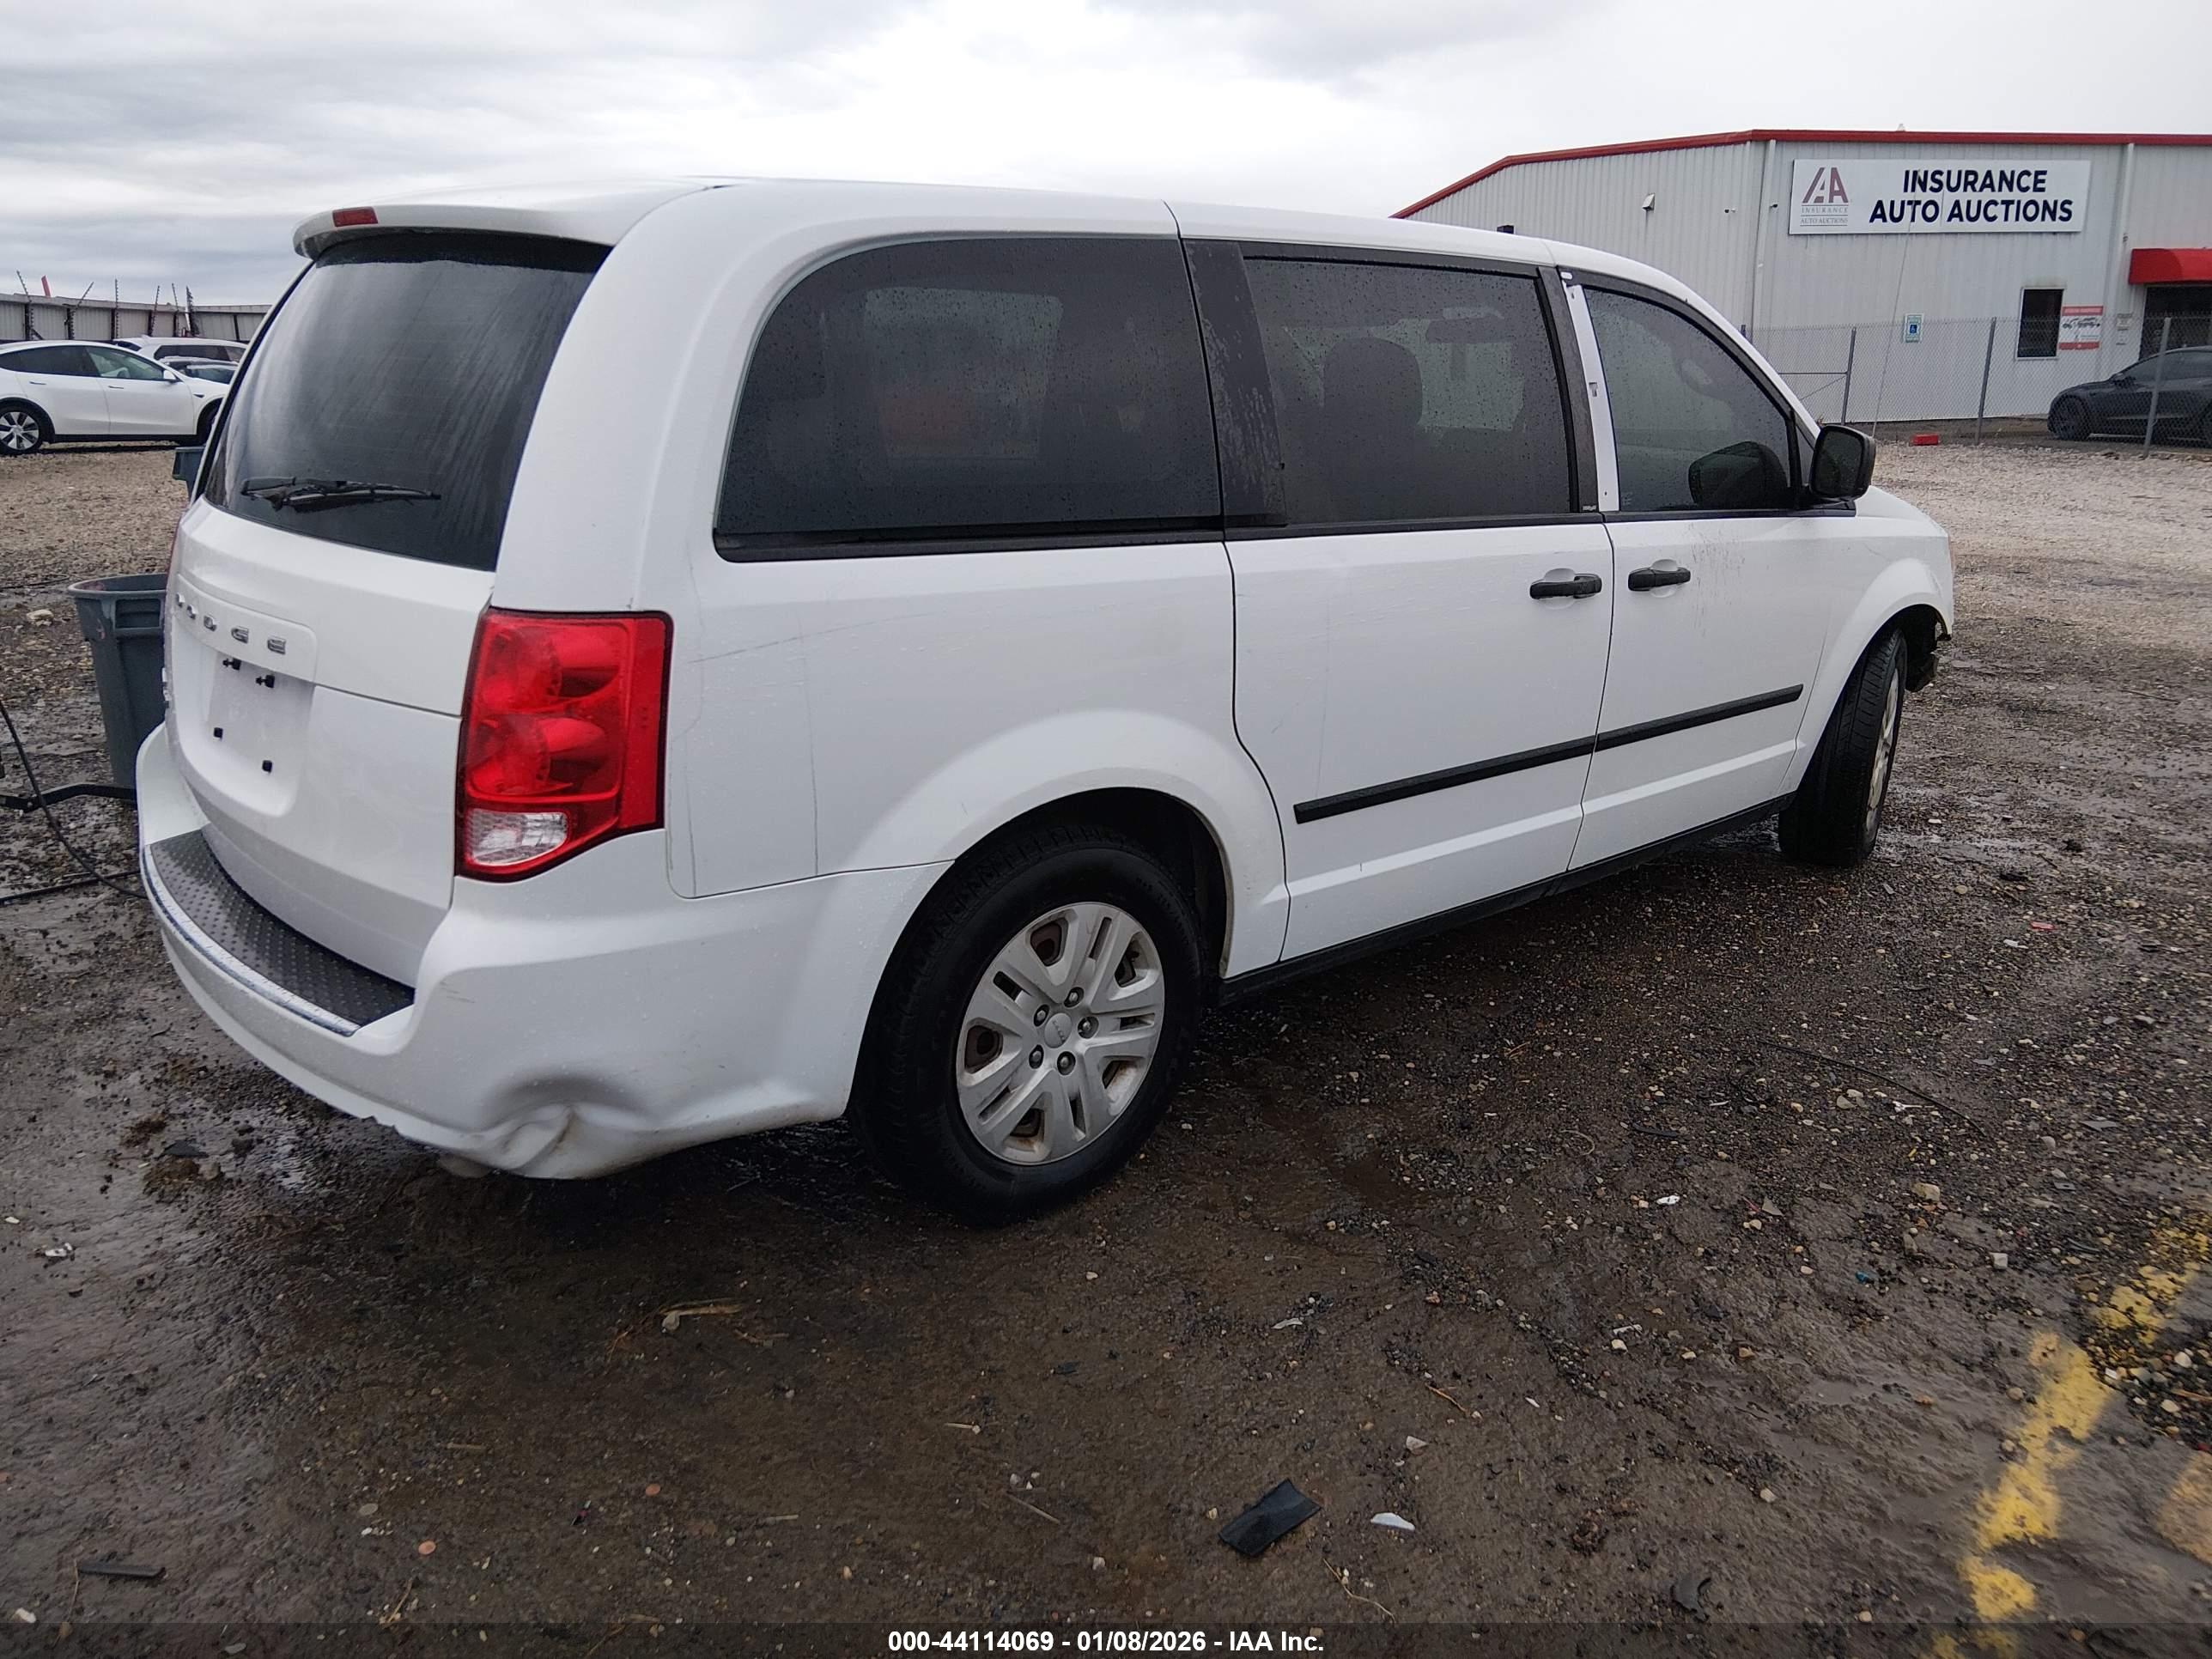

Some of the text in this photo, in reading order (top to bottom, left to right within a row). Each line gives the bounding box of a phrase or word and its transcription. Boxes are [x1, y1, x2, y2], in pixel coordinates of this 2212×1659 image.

[1902, 169, 2048, 193] INSURANCE
[1869, 199, 2074, 223] AUTO AUCTIONS
